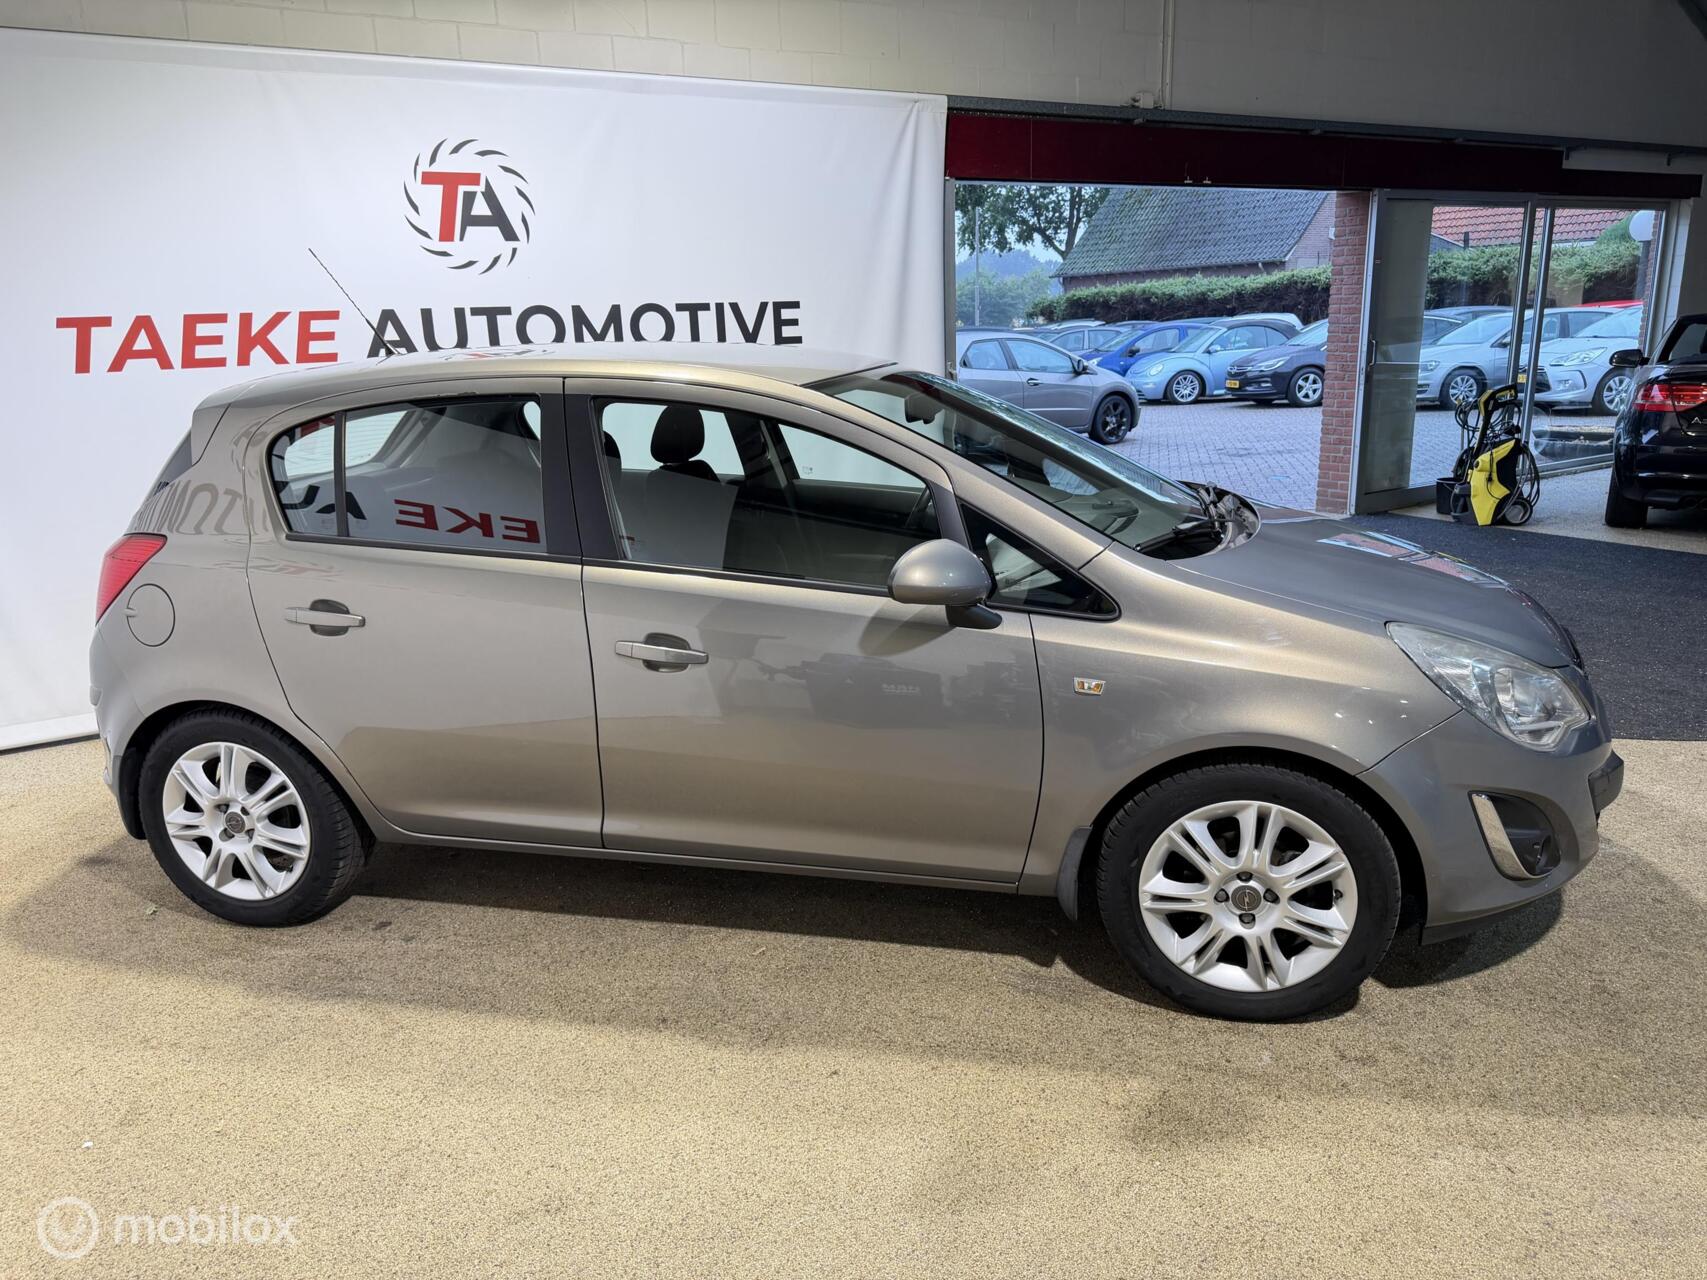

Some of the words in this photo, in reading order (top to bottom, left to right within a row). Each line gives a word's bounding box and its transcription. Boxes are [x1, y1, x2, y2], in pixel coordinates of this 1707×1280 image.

[421, 171, 520, 242] TA
[56, 310, 340, 374] TAEKE
[367, 301, 802, 358] AUTOMOTIVE
